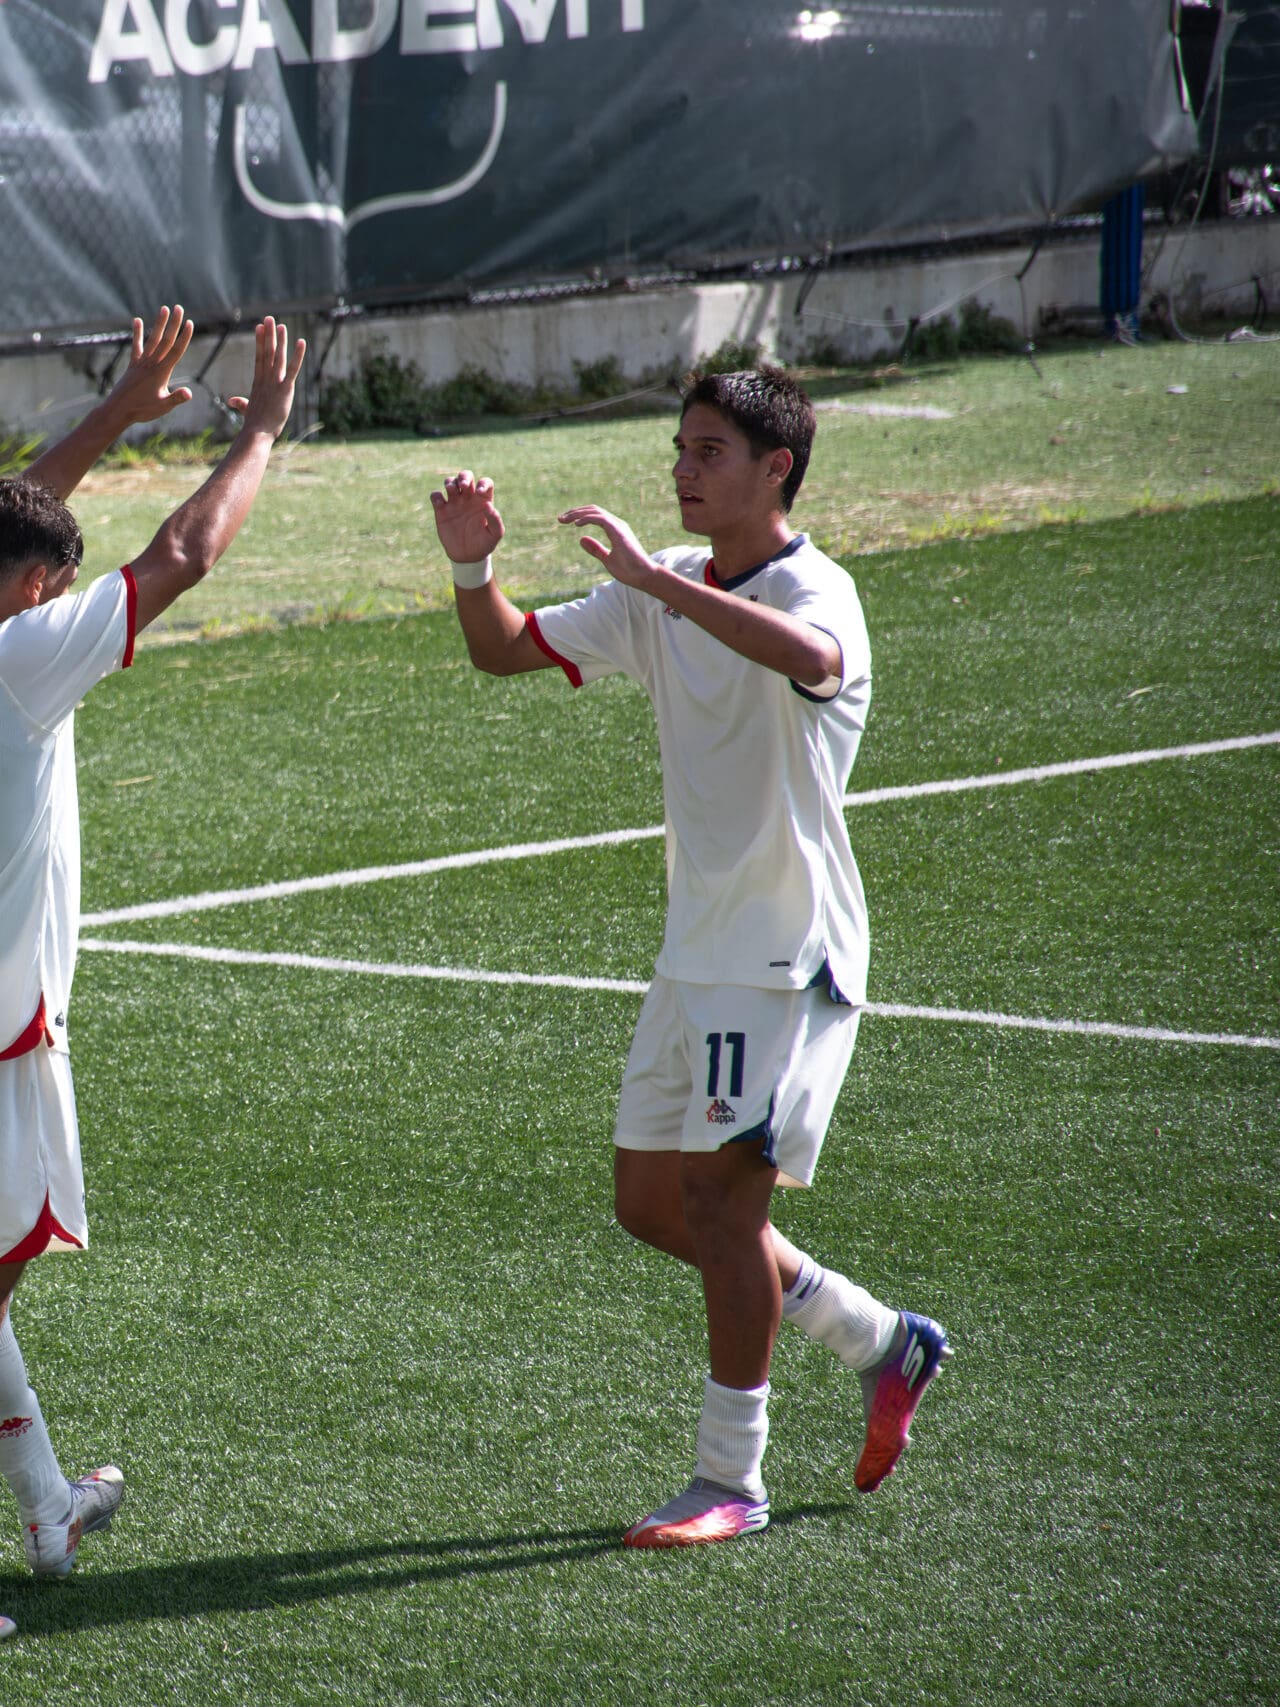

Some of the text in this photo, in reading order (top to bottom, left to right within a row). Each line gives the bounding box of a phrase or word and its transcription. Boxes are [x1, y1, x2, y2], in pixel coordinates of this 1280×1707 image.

[664, 605, 682, 621] Kapp
[706, 1032, 745, 1097] 11
[707, 1111, 736, 1125] Kappa
